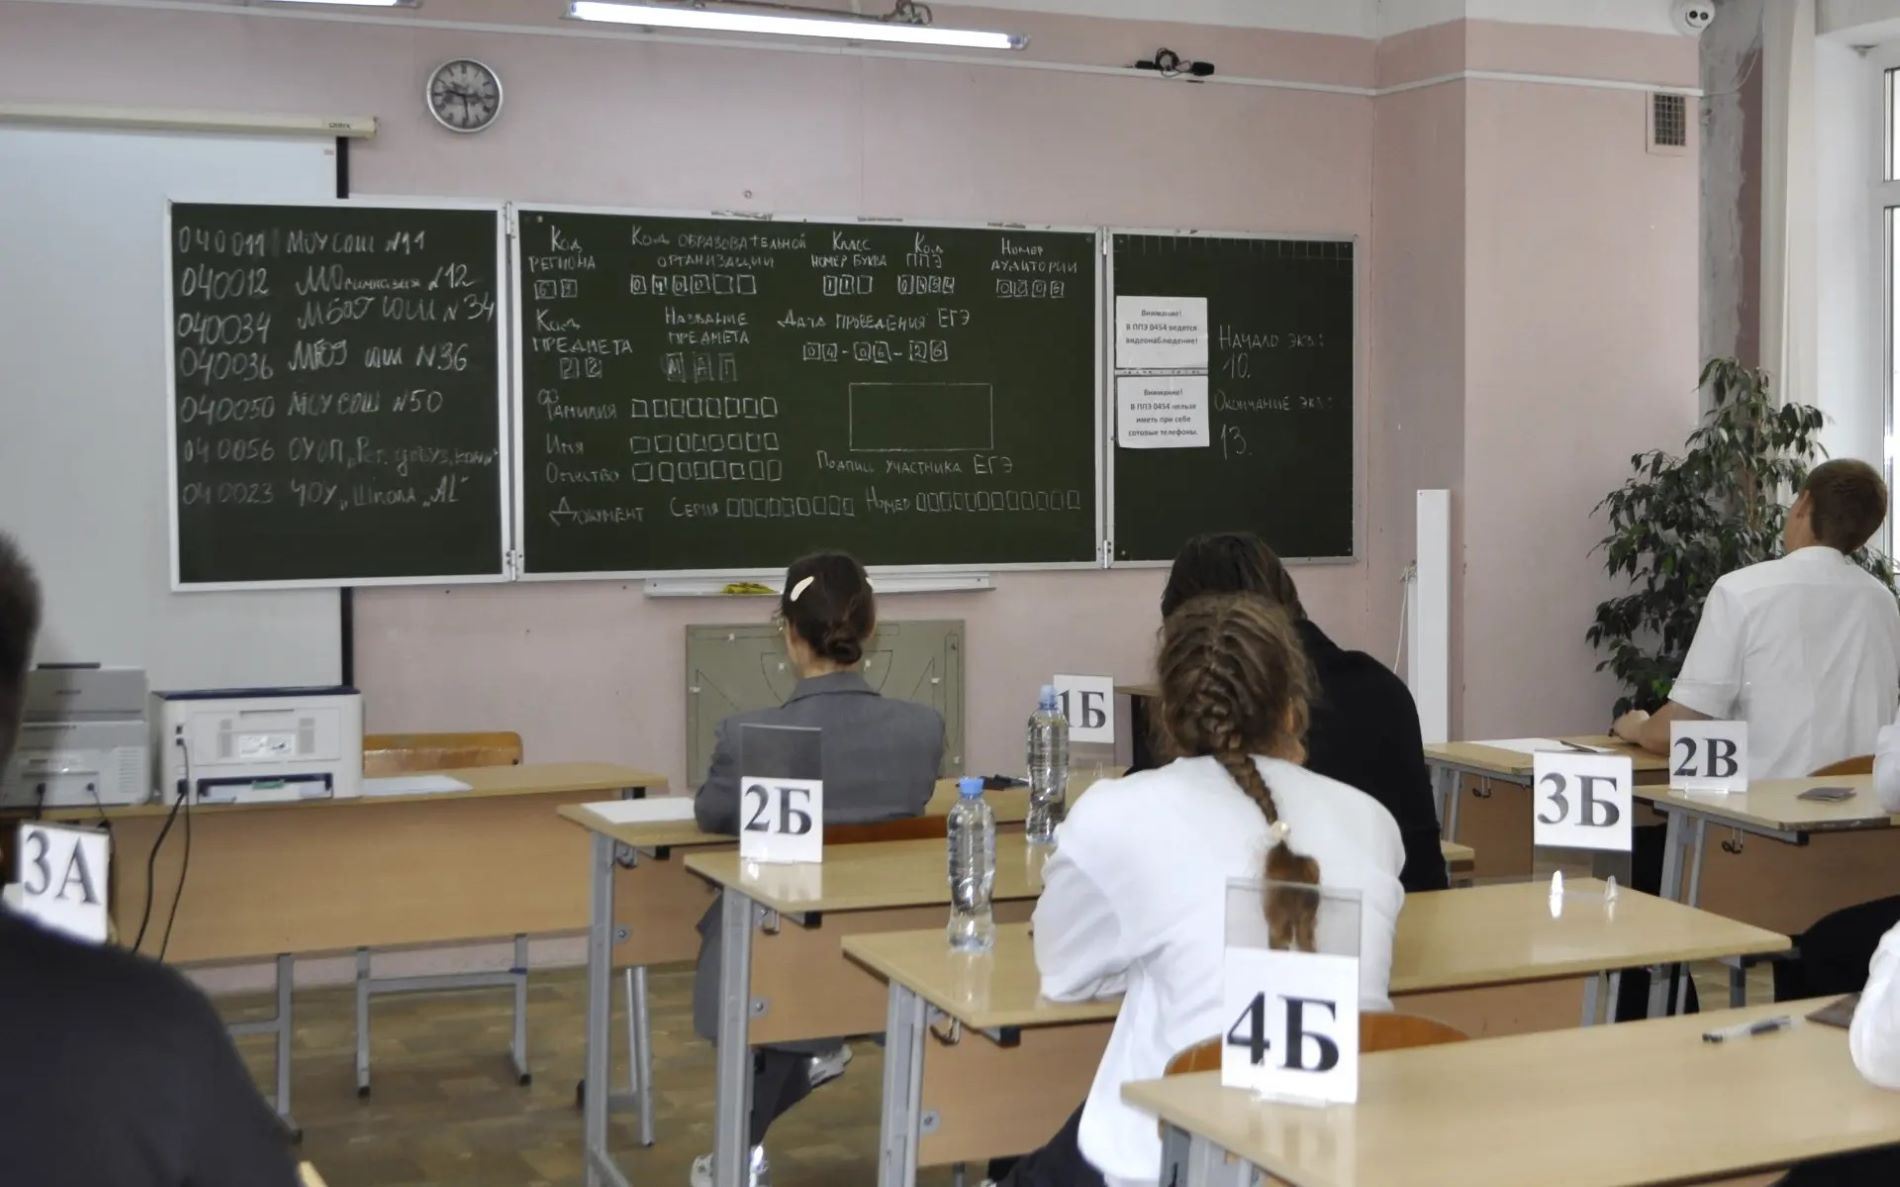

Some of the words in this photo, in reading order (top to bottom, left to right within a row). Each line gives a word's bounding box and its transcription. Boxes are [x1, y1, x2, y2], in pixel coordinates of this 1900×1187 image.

[179, 226, 265, 257] 040011
[906, 252, 942, 269] ППЭ
[182, 263, 269, 300] 040012
[178, 311, 271, 345] 040034
[937, 306, 970, 327] ЕГЭ
[179, 345, 273, 386] 040036
[181, 395, 274, 427] 040050
[184, 436, 275, 463] 040056
[973, 453, 1013, 475] ЕГЭ
[183, 482, 275, 505] 040023
[1057, 689, 1106, 729] 1Б
[1673, 736, 1739, 778] 2В
[744, 783, 813, 835] 2Б
[1537, 772, 1620, 828] 3Б
[24, 829, 101, 904] 3А
[1226, 990, 1340, 1073] 4Б
